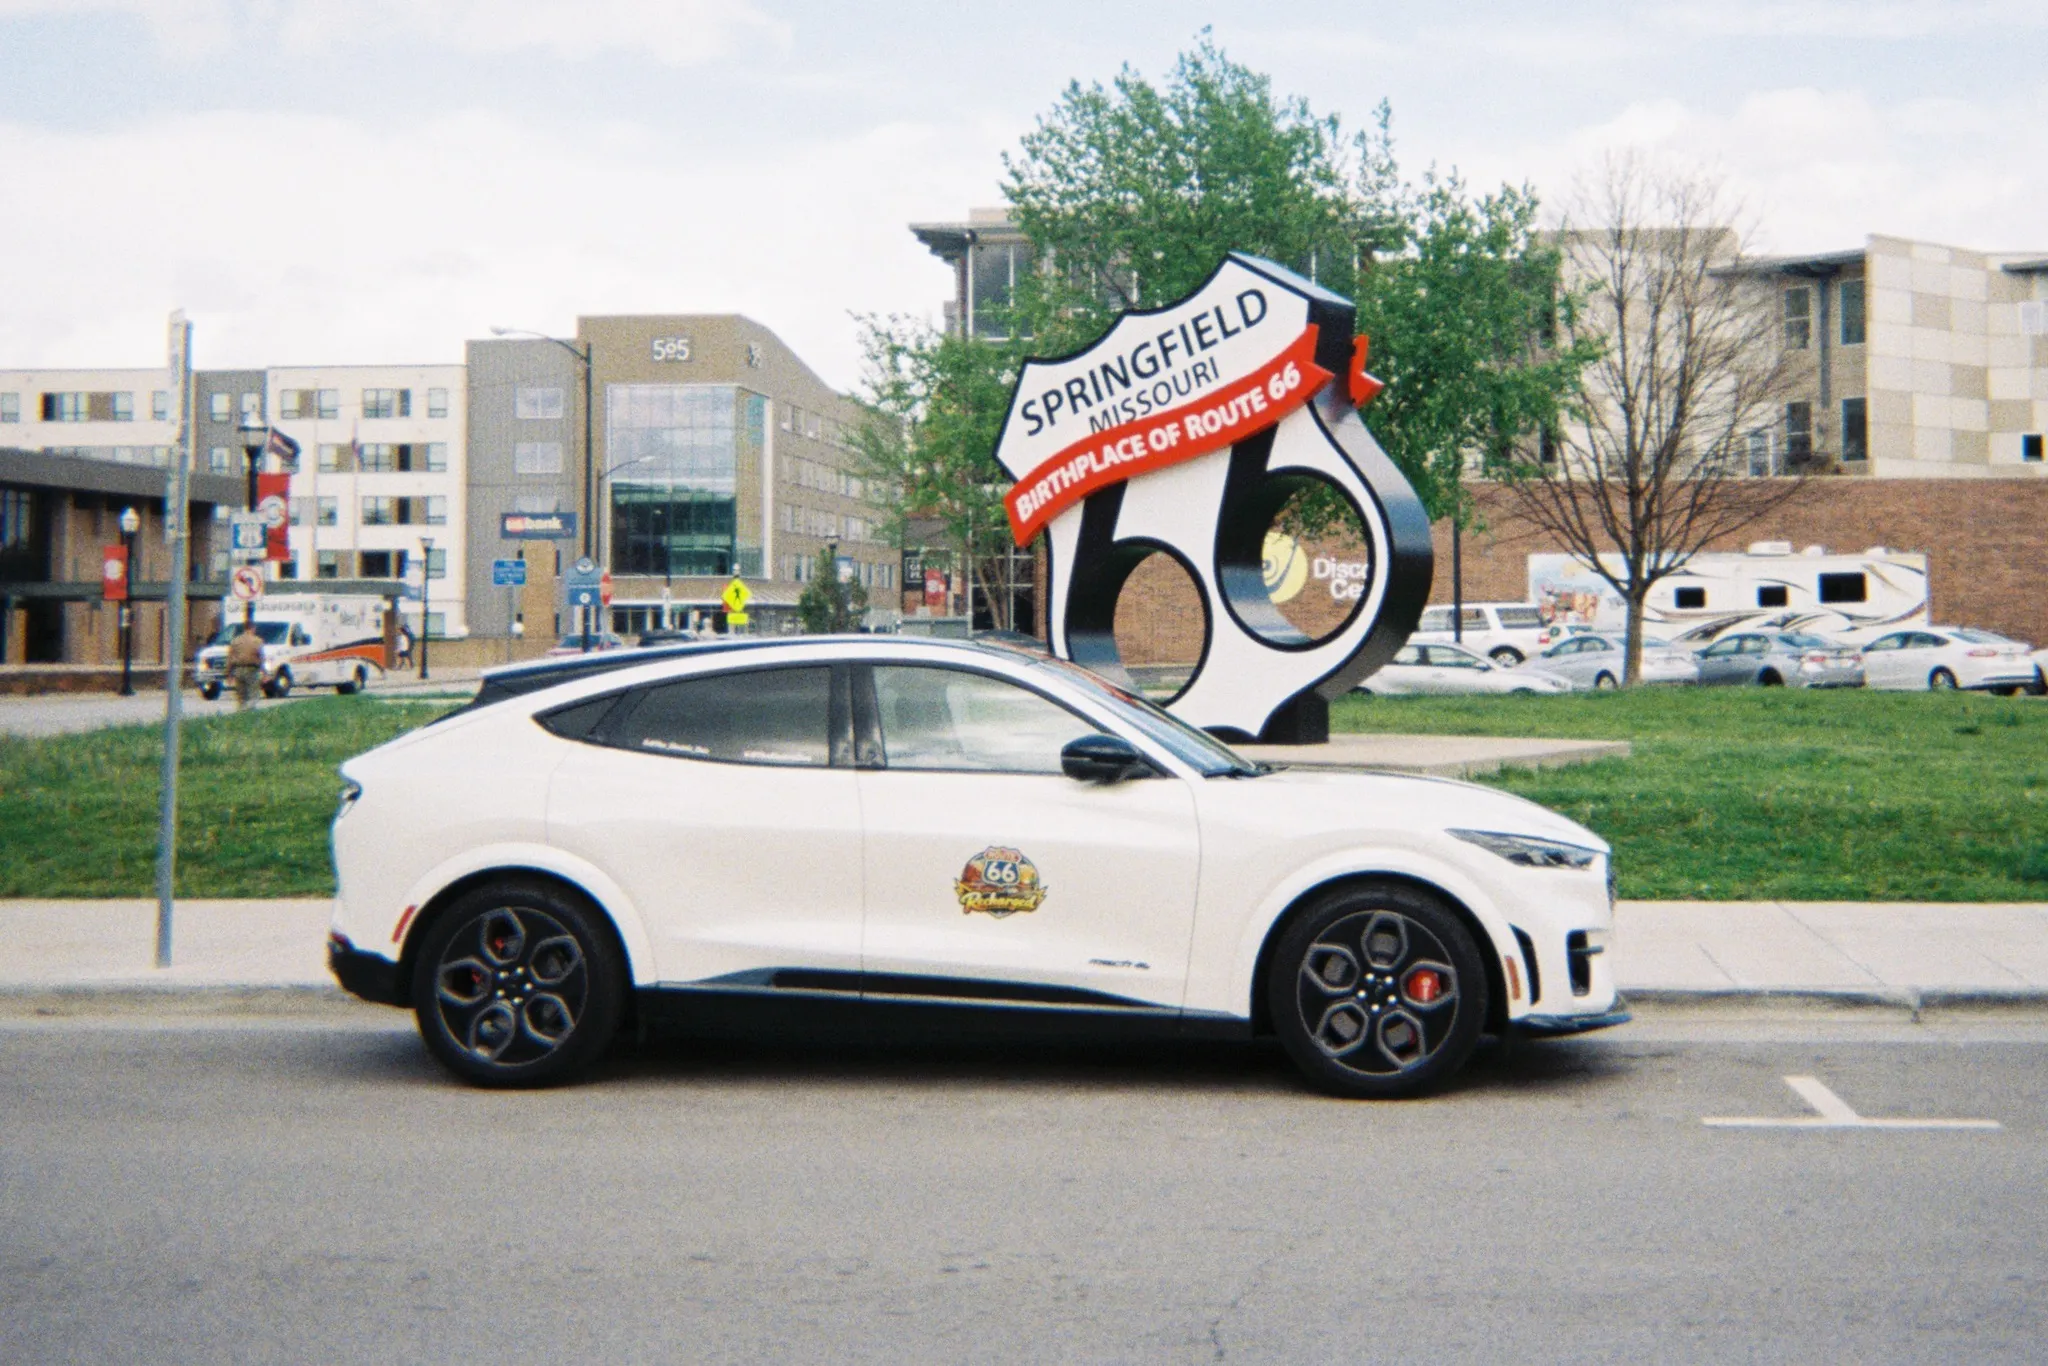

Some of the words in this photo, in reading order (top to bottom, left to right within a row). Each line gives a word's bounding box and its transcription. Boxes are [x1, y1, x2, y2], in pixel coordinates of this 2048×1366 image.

[653, 339, 690, 361] 505
[1021, 288, 1268, 437] SPRINGFIELD
[1089, 356, 1220, 435] MISSOURI
[1015, 434, 1147, 523] BIRTHPLACE
[1147, 428, 1182, 453] OF
[1184, 386, 1268, 440] ROUTE
[1268, 360, 1302, 399] 66
[987, 861, 1017, 881] 66
